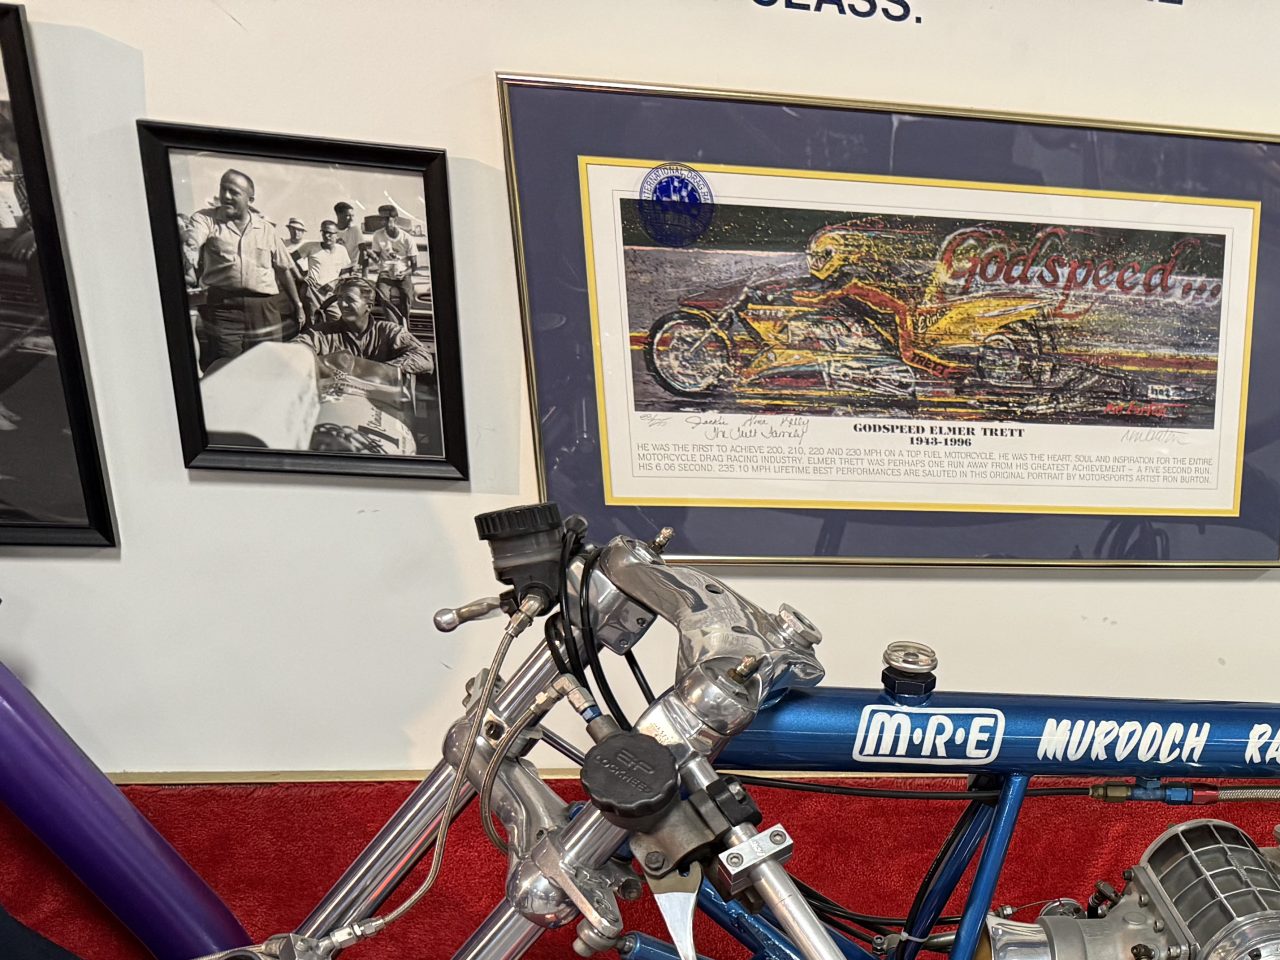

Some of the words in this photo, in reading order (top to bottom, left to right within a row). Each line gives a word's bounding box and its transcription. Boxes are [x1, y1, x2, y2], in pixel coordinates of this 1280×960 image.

[854, 422, 925, 434] GODSPEED
[930, 426, 976, 436] ELMER
[981, 428, 1025, 438] TRETT
[910, 436, 972, 448] 1943-1996
[637, 442, 649, 451] HE
[651, 443, 669, 452] WAS
[672, 443, 689, 452] THE
[692, 444, 713, 453] FIRST
[716, 444, 727, 453] TO
[729, 445, 764, 454] ACHIEVE
[808, 447, 824, 456] 220
[826, 447, 842, 456] AND
[845, 448, 860, 456] 230
[863, 448, 881, 457] MPH
[884, 449, 894, 457] ON
[898, 449, 905, 458] A
[906, 449, 920, 458] TOP
[924, 450, 941, 458] FUEL
[998, 451, 1008, 460] HE
[1011, 452, 1027, 461] WAS
[1030, 452, 1044, 461] THE
[1074, 453, 1092, 462] SOUL
[1095, 454, 1110, 463] AND
[1112, 454, 1153, 464] INSPIRATION
[1156, 455, 1169, 464] FOR
[1172, 456, 1186, 465] THE
[1188, 456, 1212, 465] ENTIRE
[638, 452, 695, 462] MOTORCYCLE
[699, 454, 723, 463] DRAG
[726, 454, 758, 464] RACING
[808, 456, 835, 466] ELMER
[838, 457, 863, 466] TRETT
[867, 458, 884, 467] WAS
[888, 458, 924, 468] PERHAPS
[928, 459, 944, 468] ONE
[947, 460, 963, 469] RUN
[967, 460, 988, 469] AWAY
[991, 461, 1012, 470] FROM
[1016, 461, 1028, 470] HIS
[1030, 462, 1069, 471] GREATEST
[1036, 717, 1211, 763] MURDOCH
